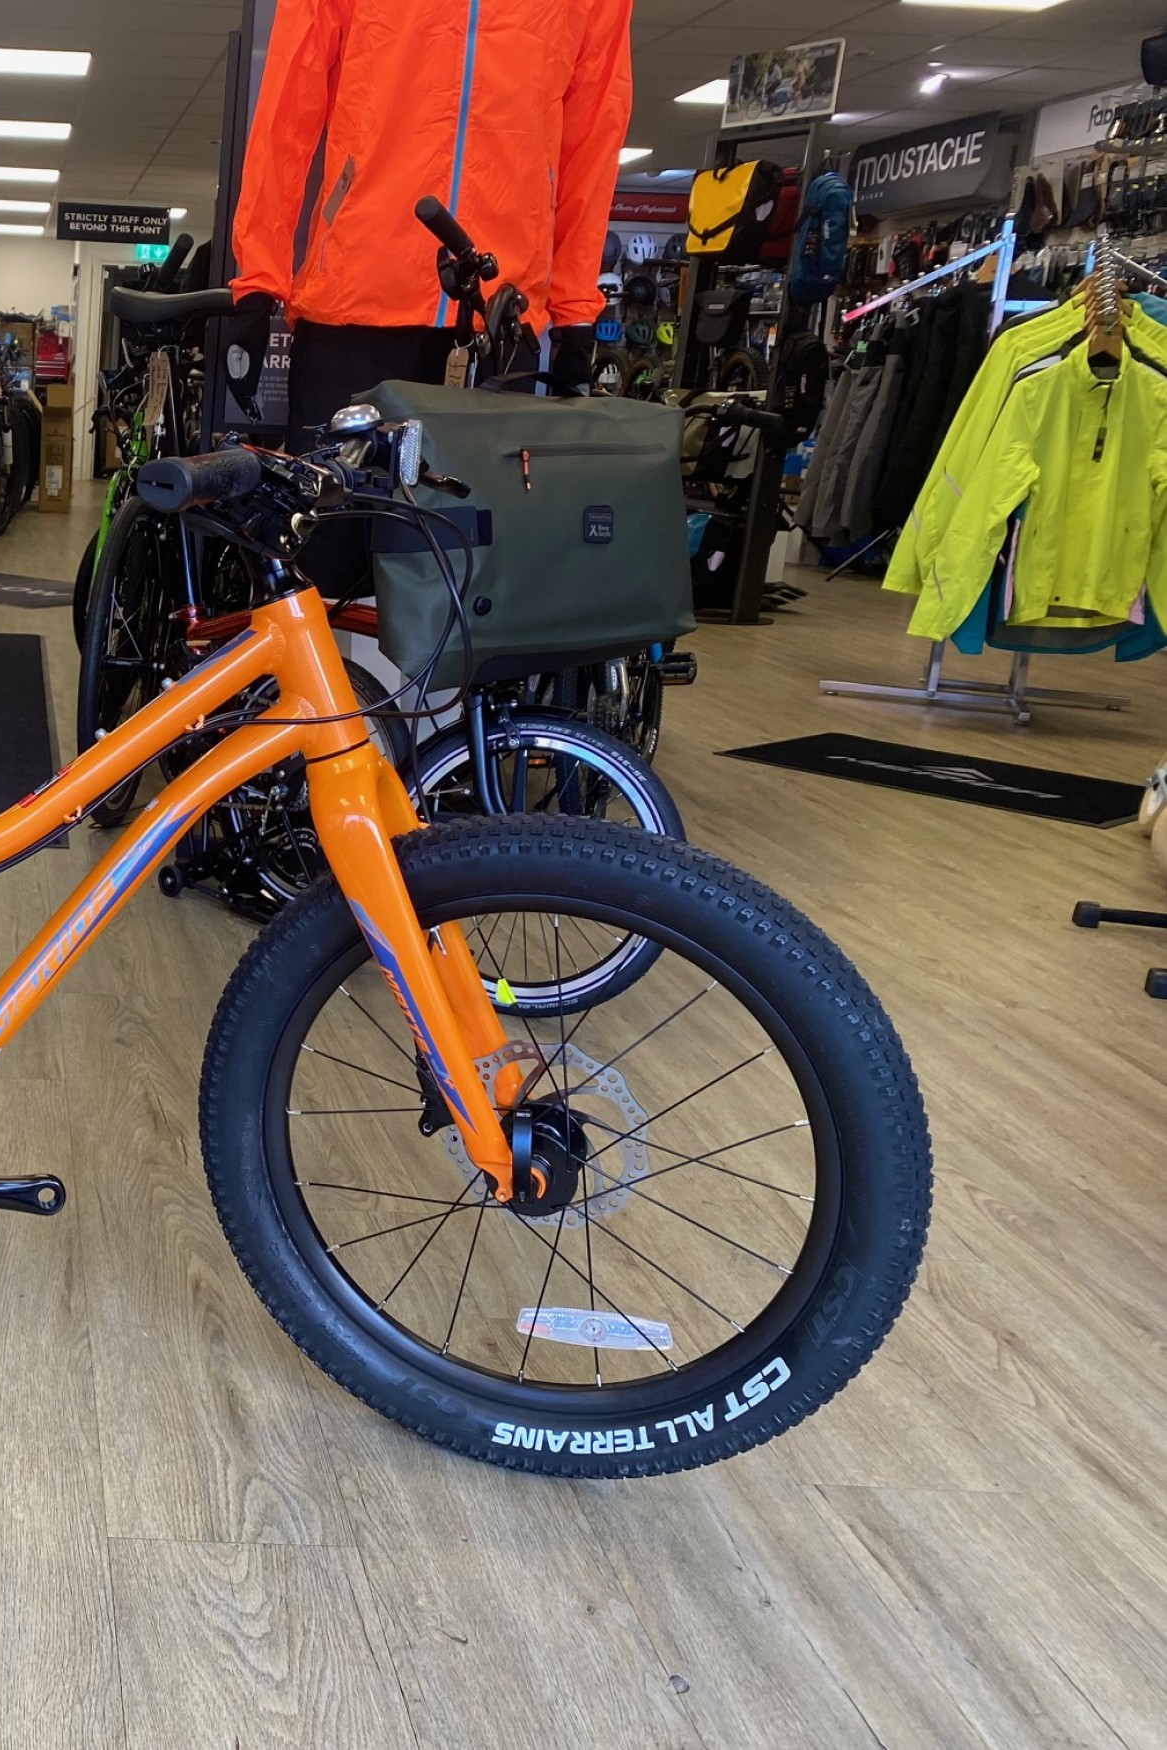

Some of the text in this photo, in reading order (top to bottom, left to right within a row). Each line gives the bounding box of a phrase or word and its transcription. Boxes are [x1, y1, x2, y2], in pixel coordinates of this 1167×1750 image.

[854, 131, 986, 202] MOUSTACHE
[64, 212, 168, 226] STRICTLY STAFF ONLY
[69, 222, 162, 235] BEYOND THIS POINT
[491, 1356, 792, 1455] CST ALL TERRAINS
